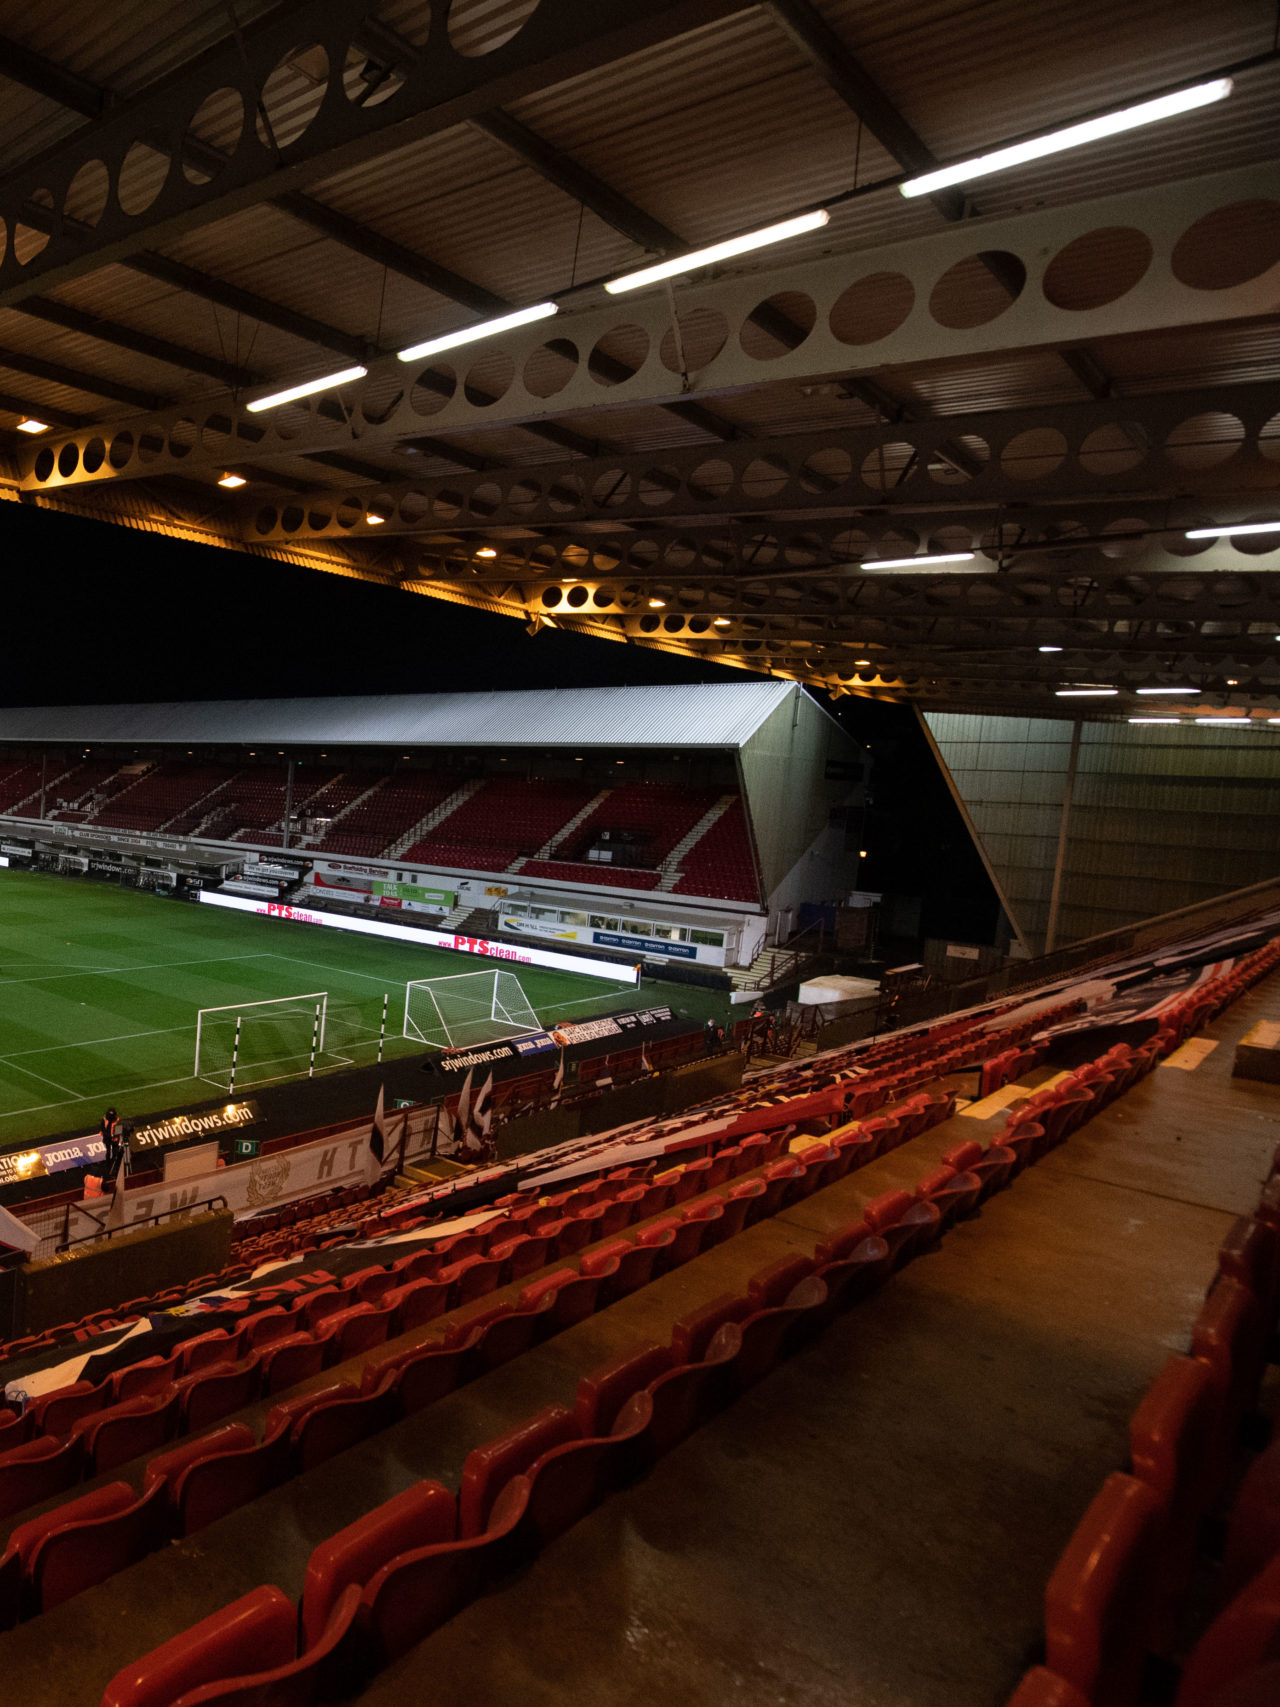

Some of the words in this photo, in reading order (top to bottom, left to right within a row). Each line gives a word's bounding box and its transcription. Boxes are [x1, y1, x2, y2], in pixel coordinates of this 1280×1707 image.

[440, 1046, 514, 1072] srjwindows.com
[136, 1106, 253, 1146] srjwindows.com
[242, 1142, 252, 1153] D
